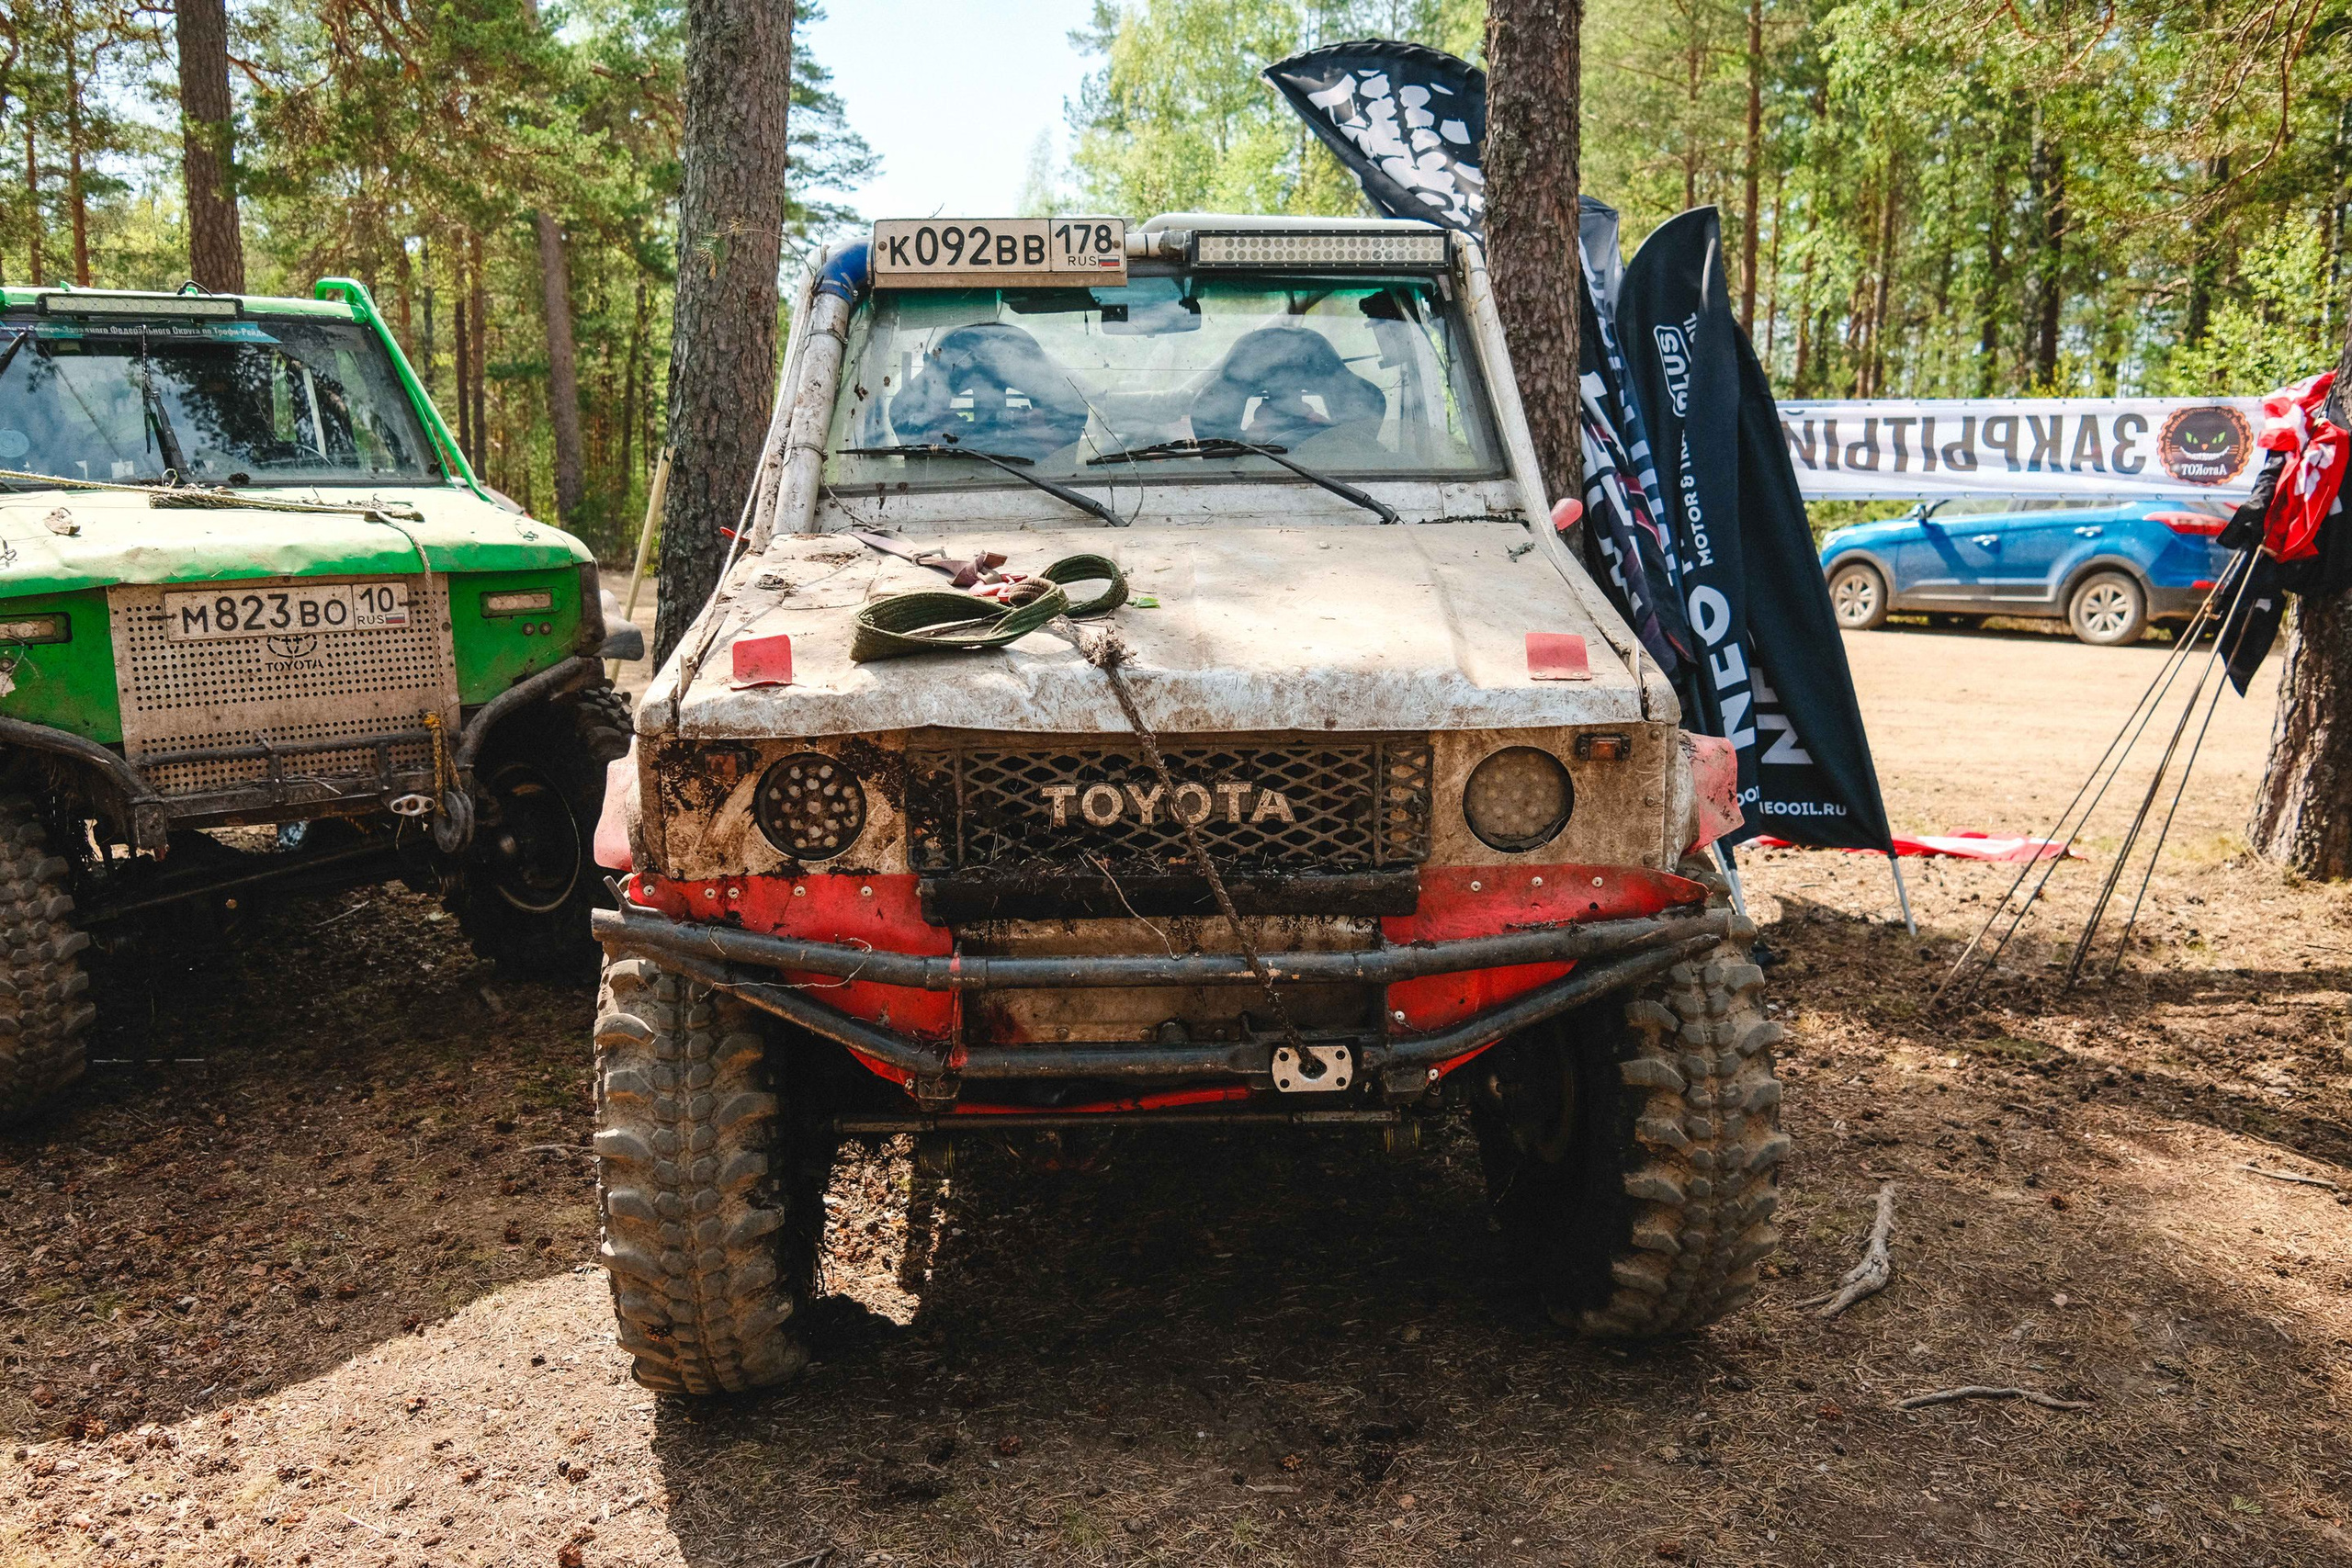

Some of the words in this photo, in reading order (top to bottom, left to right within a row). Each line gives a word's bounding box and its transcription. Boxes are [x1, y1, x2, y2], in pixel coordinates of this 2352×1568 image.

[1054, 223, 1114, 254] 178
[1067, 254, 1097, 266] RUS
[1680, 475, 1695, 489] &
[1683, 491, 1713, 567] MOTOR
[359, 587, 394, 614] 10
[357, 615, 385, 626] RUS
[266, 658, 324, 672] TOYOTA
[1689, 585, 1756, 750] NEO
[1039, 781, 1296, 827] TOYOTA
